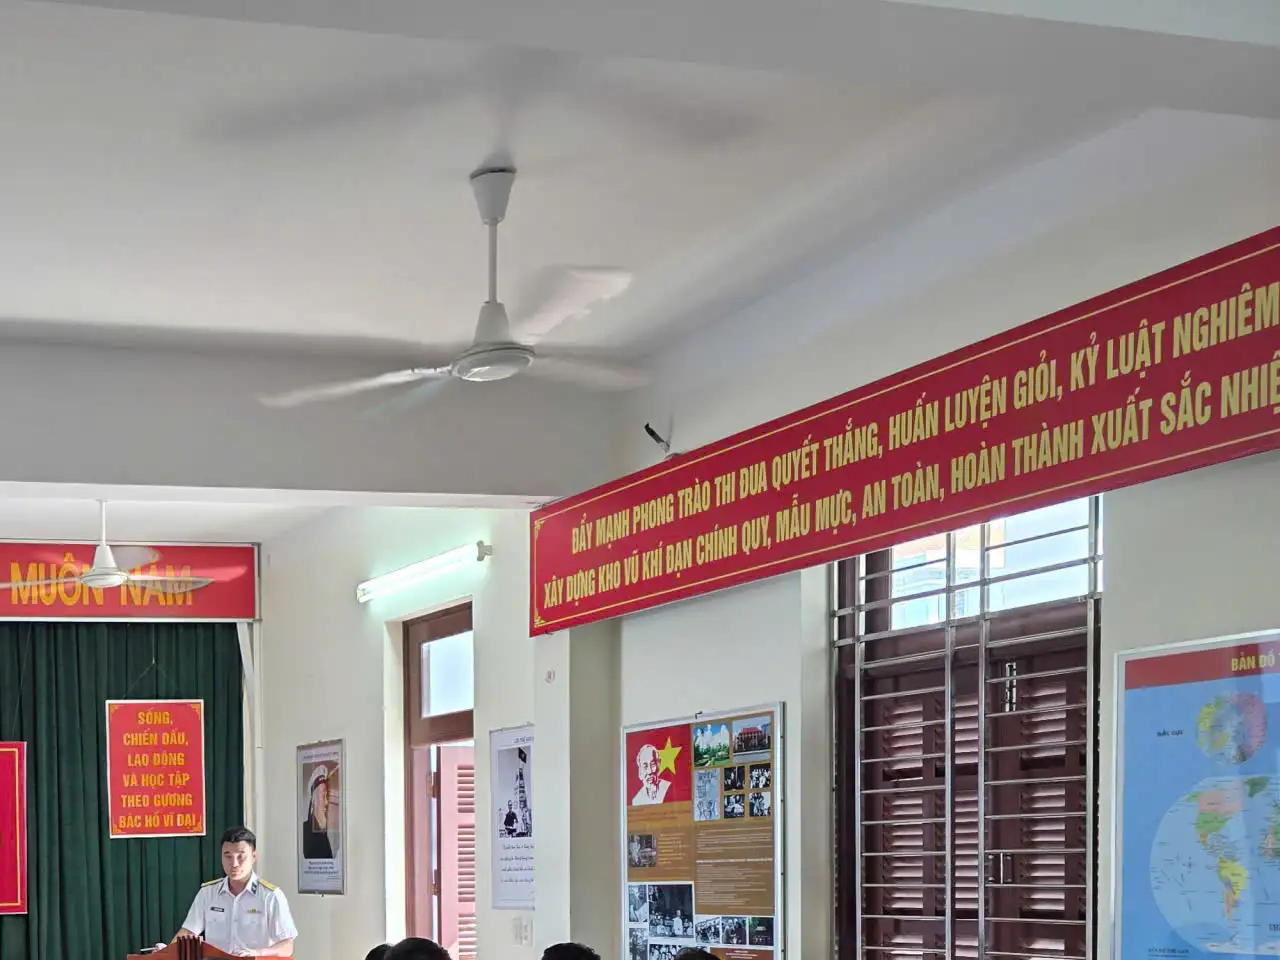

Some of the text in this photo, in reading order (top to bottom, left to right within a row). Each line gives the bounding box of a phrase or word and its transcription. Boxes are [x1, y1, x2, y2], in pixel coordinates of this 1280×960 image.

[572, 282, 1280, 555] ĐẨY MẠNH PHONG TRÀO THI ĐUA QUYẾT THẮNG, HUẤN LUYỆN GIỎI, KỶ LUẬT NGHIÊM
[544, 575, 564, 608] XÂY
[566, 569, 596, 606] DỰNG
[599, 560, 620, 593] KHO
[624, 549, 640, 586] VŨ
[642, 541, 662, 581] KHÍ
[666, 538, 692, 578] ĐẠN
[696, 524, 738, 565] CHÍNH
[742, 515, 771, 555] QUY,
[776, 493, 810, 542] MẪU
[816, 489, 857, 535] MỰC,
[862, 480, 886, 520] AN
[892, 461, 944, 508] TOÀN,
[951, 437, 1005, 494] HOÀN
[1012, 422, 1084, 476] THÀNH
[1091, 387, 1152, 455] XUẤT
[1160, 371, 1212, 435] SẮC
[10, 552, 104, 606] MUÔN
[123, 728, 158, 746] CHIẾN
[127, 754, 150, 767] LAO
[123, 770, 190, 789] VÀ HỌC TẬP
[121, 793, 192, 808] THEO GƯƠNG
[118, 812, 142, 828] BÁC
